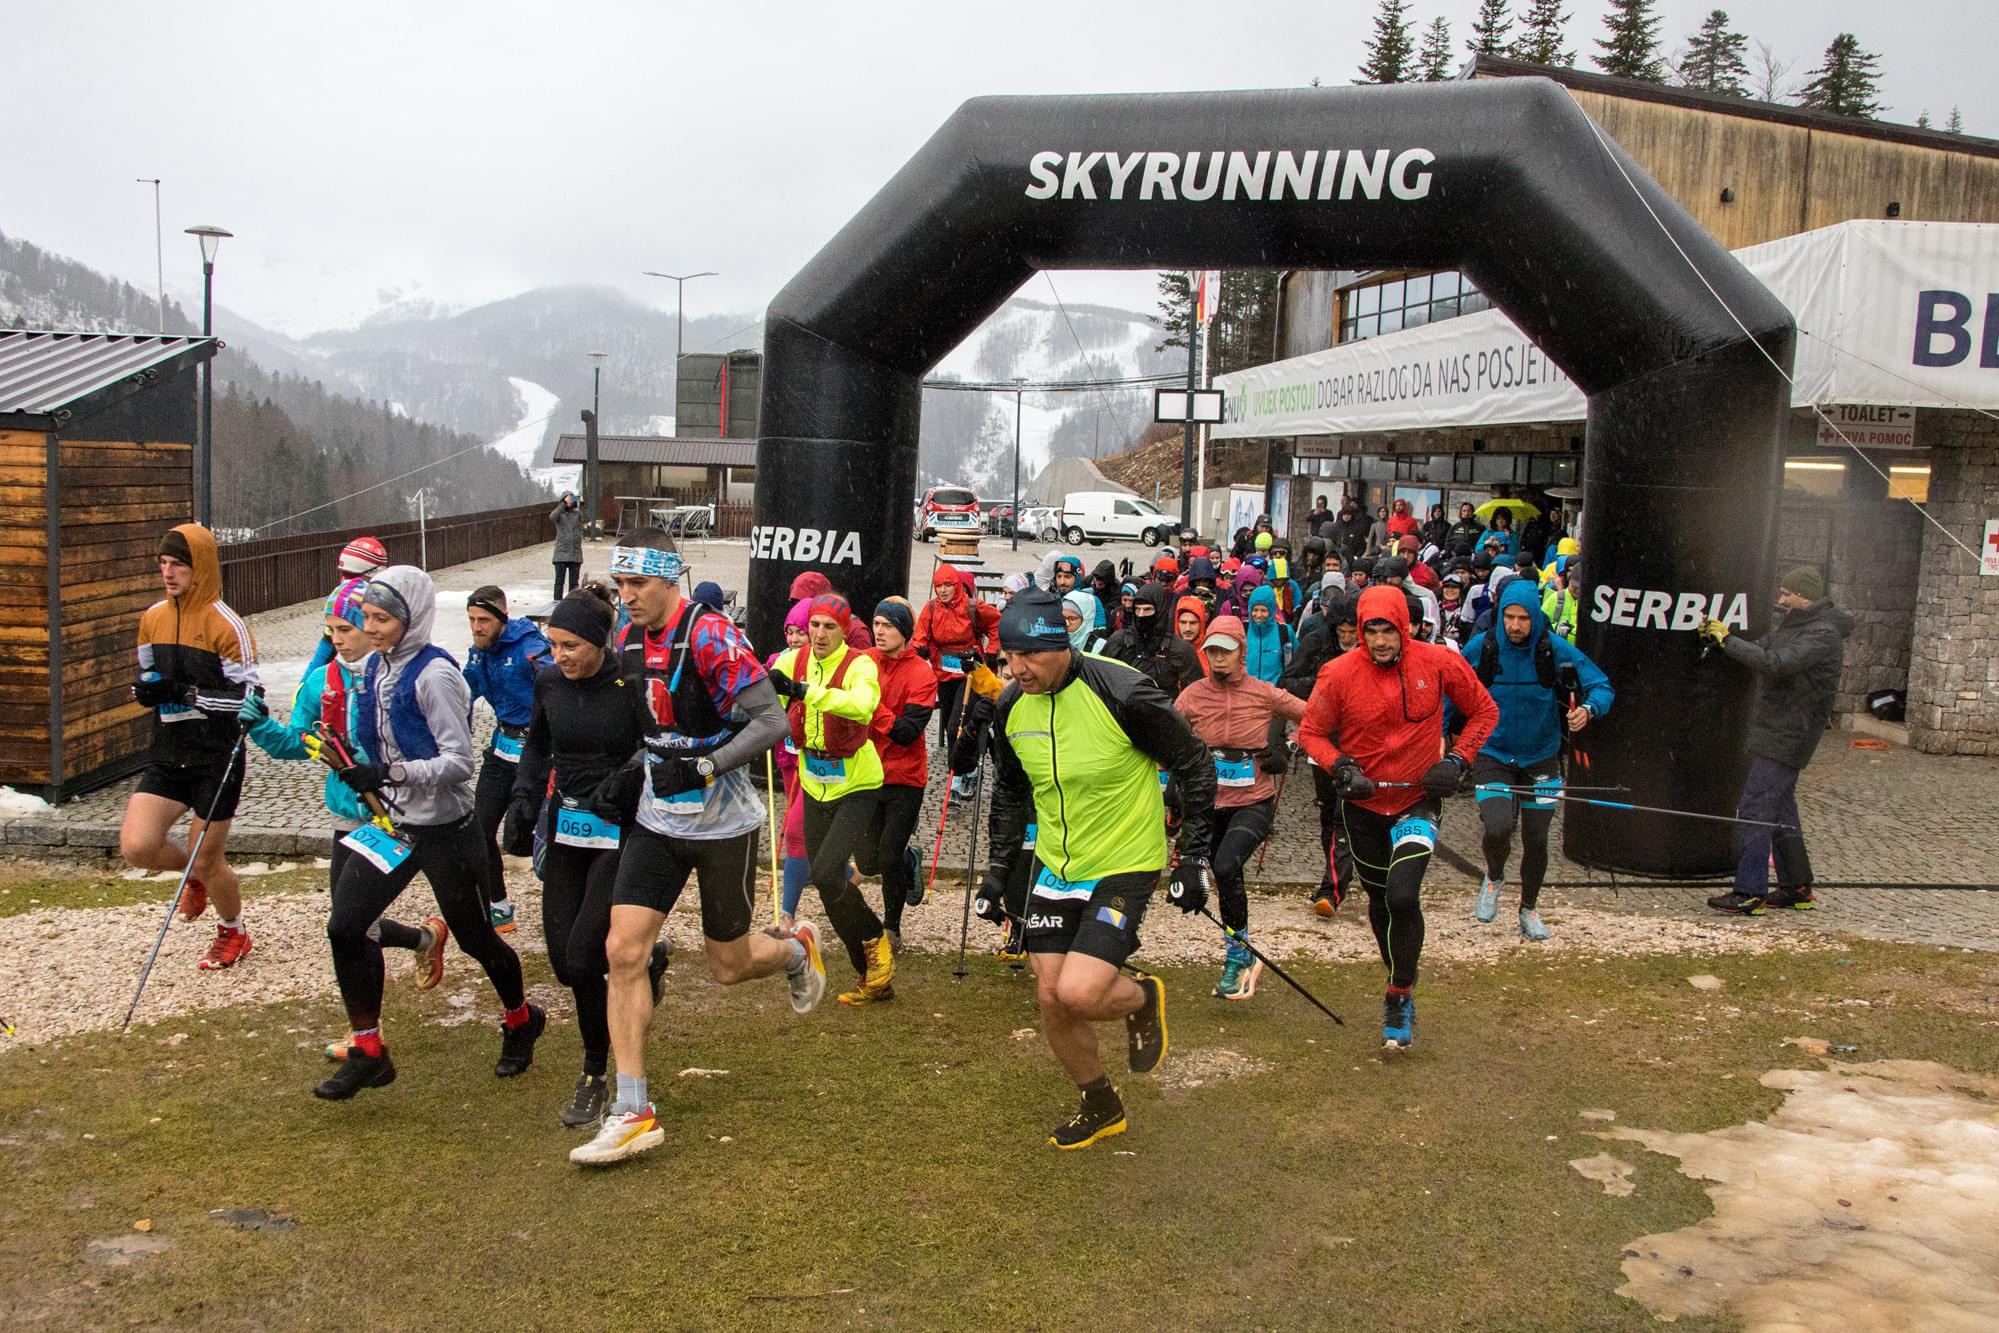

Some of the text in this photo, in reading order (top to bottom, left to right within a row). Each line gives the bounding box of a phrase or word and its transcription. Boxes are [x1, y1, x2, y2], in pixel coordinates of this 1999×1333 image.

[1024, 148, 1436, 200] SKYRUNNING
[1253, 388, 1278, 416] UVIJEK
[1279, 382, 1316, 413] POSTOJI
[1318, 375, 1353, 409] DOBAR
[1357, 364, 1407, 403] RAZLOG
[1412, 361, 1432, 398] DA
[1438, 353, 1470, 395] NAS
[1840, 406, 1896, 422] TOALET
[1835, 430, 1911, 445] PRVA POMOĆ
[750, 525, 862, 565] SERBIA
[1590, 584, 1748, 631] SERBIA
[561, 819, 593, 838] 069
[1395, 825, 1422, 841] 085
[354, 829, 381, 849] 071
